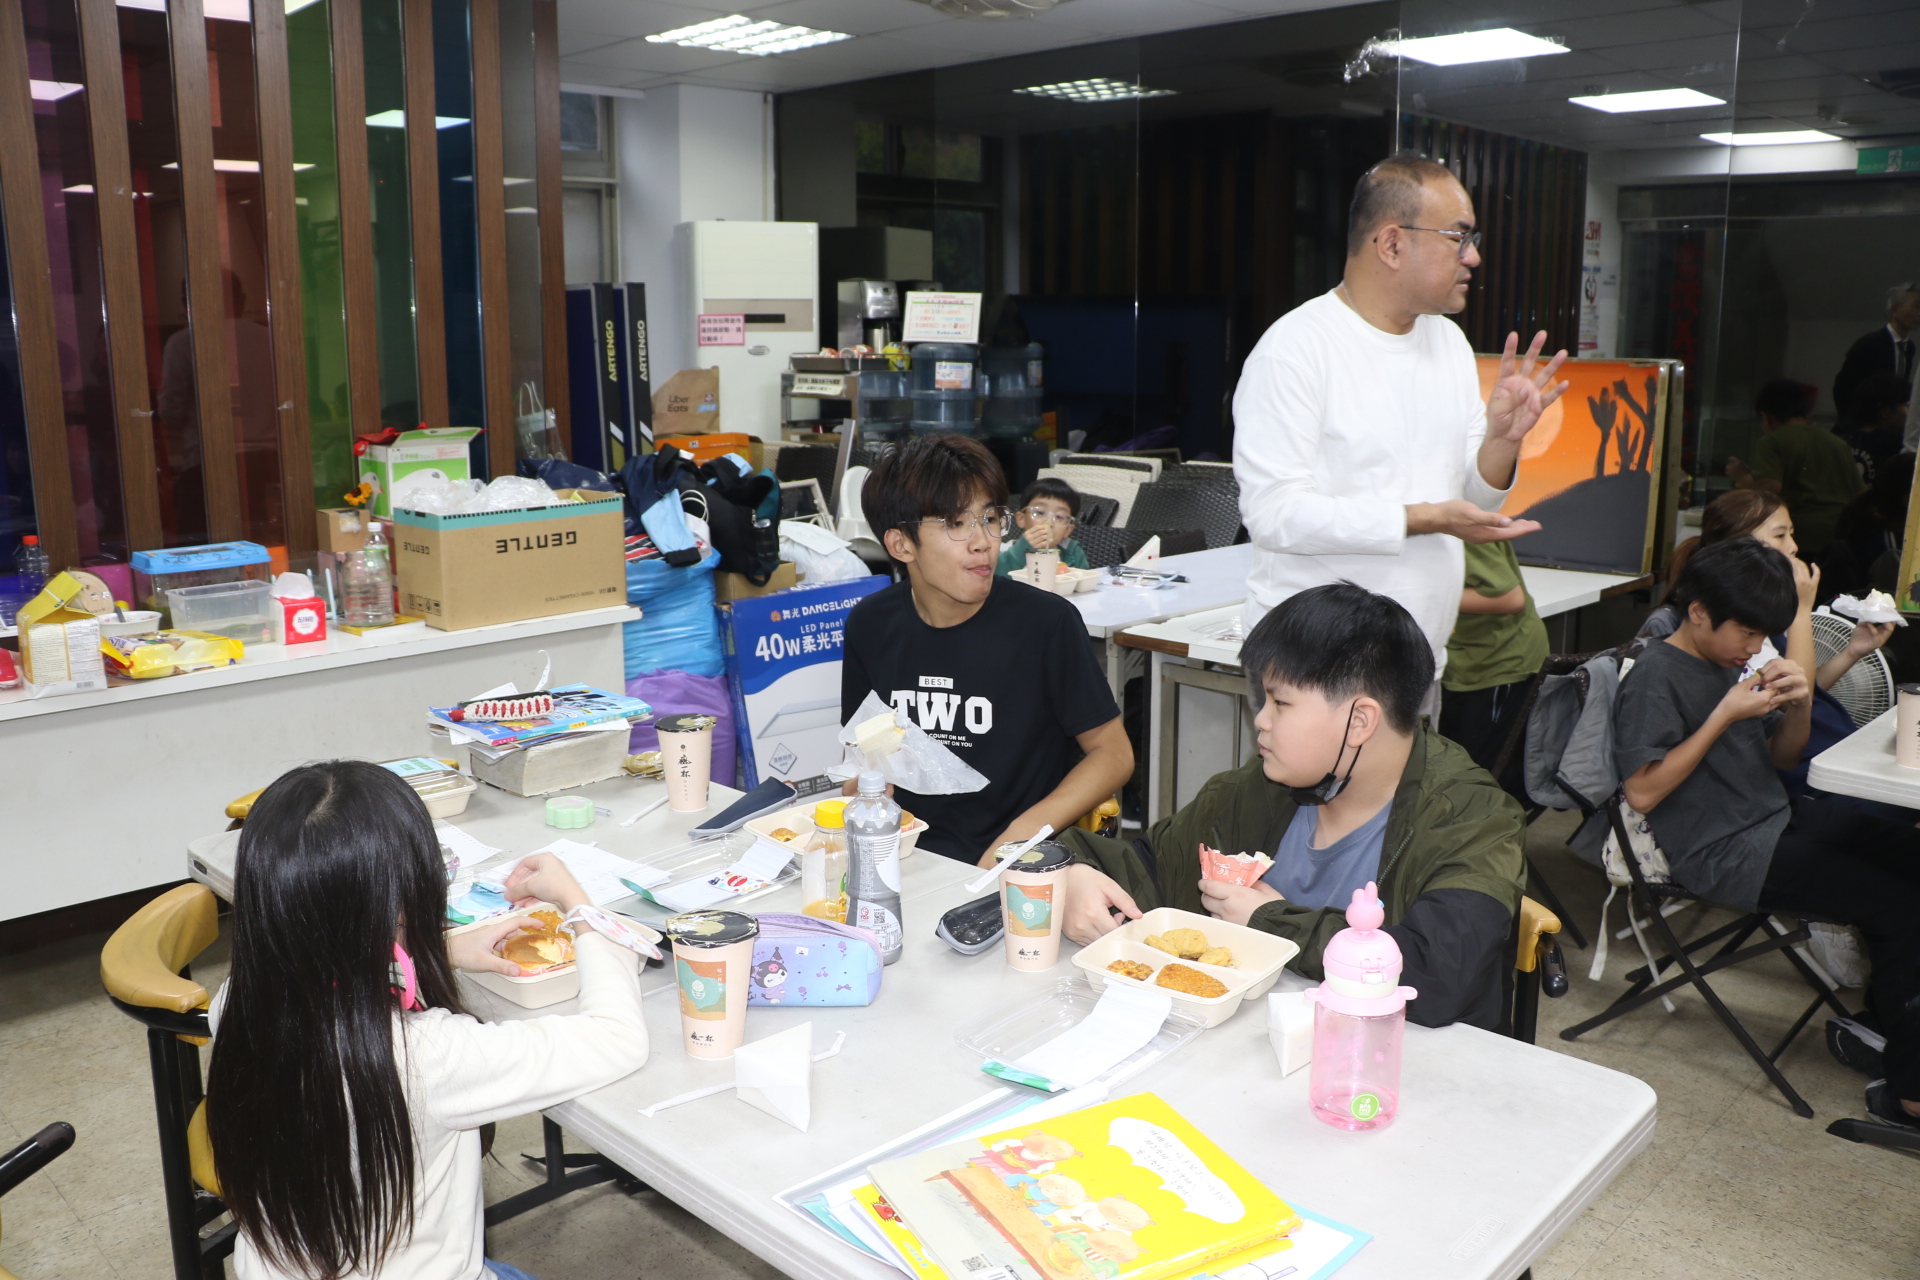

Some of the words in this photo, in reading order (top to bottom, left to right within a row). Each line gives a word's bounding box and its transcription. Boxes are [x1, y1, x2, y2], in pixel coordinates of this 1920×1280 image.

[605, 320, 618, 382] ARTENGO
[637, 320, 648, 382] ARTENGO
[669, 395, 689, 403] Uber
[667, 404, 688, 412] Eats
[403, 542, 430, 556] GENTLE
[496, 531, 577, 554] GENTLE
[782, 608, 801, 620] 舞光
[801, 624, 817, 634] LED
[820, 618, 843, 630] Panel
[755, 633, 801, 662] 40W
[802, 630, 845, 654] 柔光平
[924, 678, 948, 686] BEST
[889, 690, 993, 734] TWO
